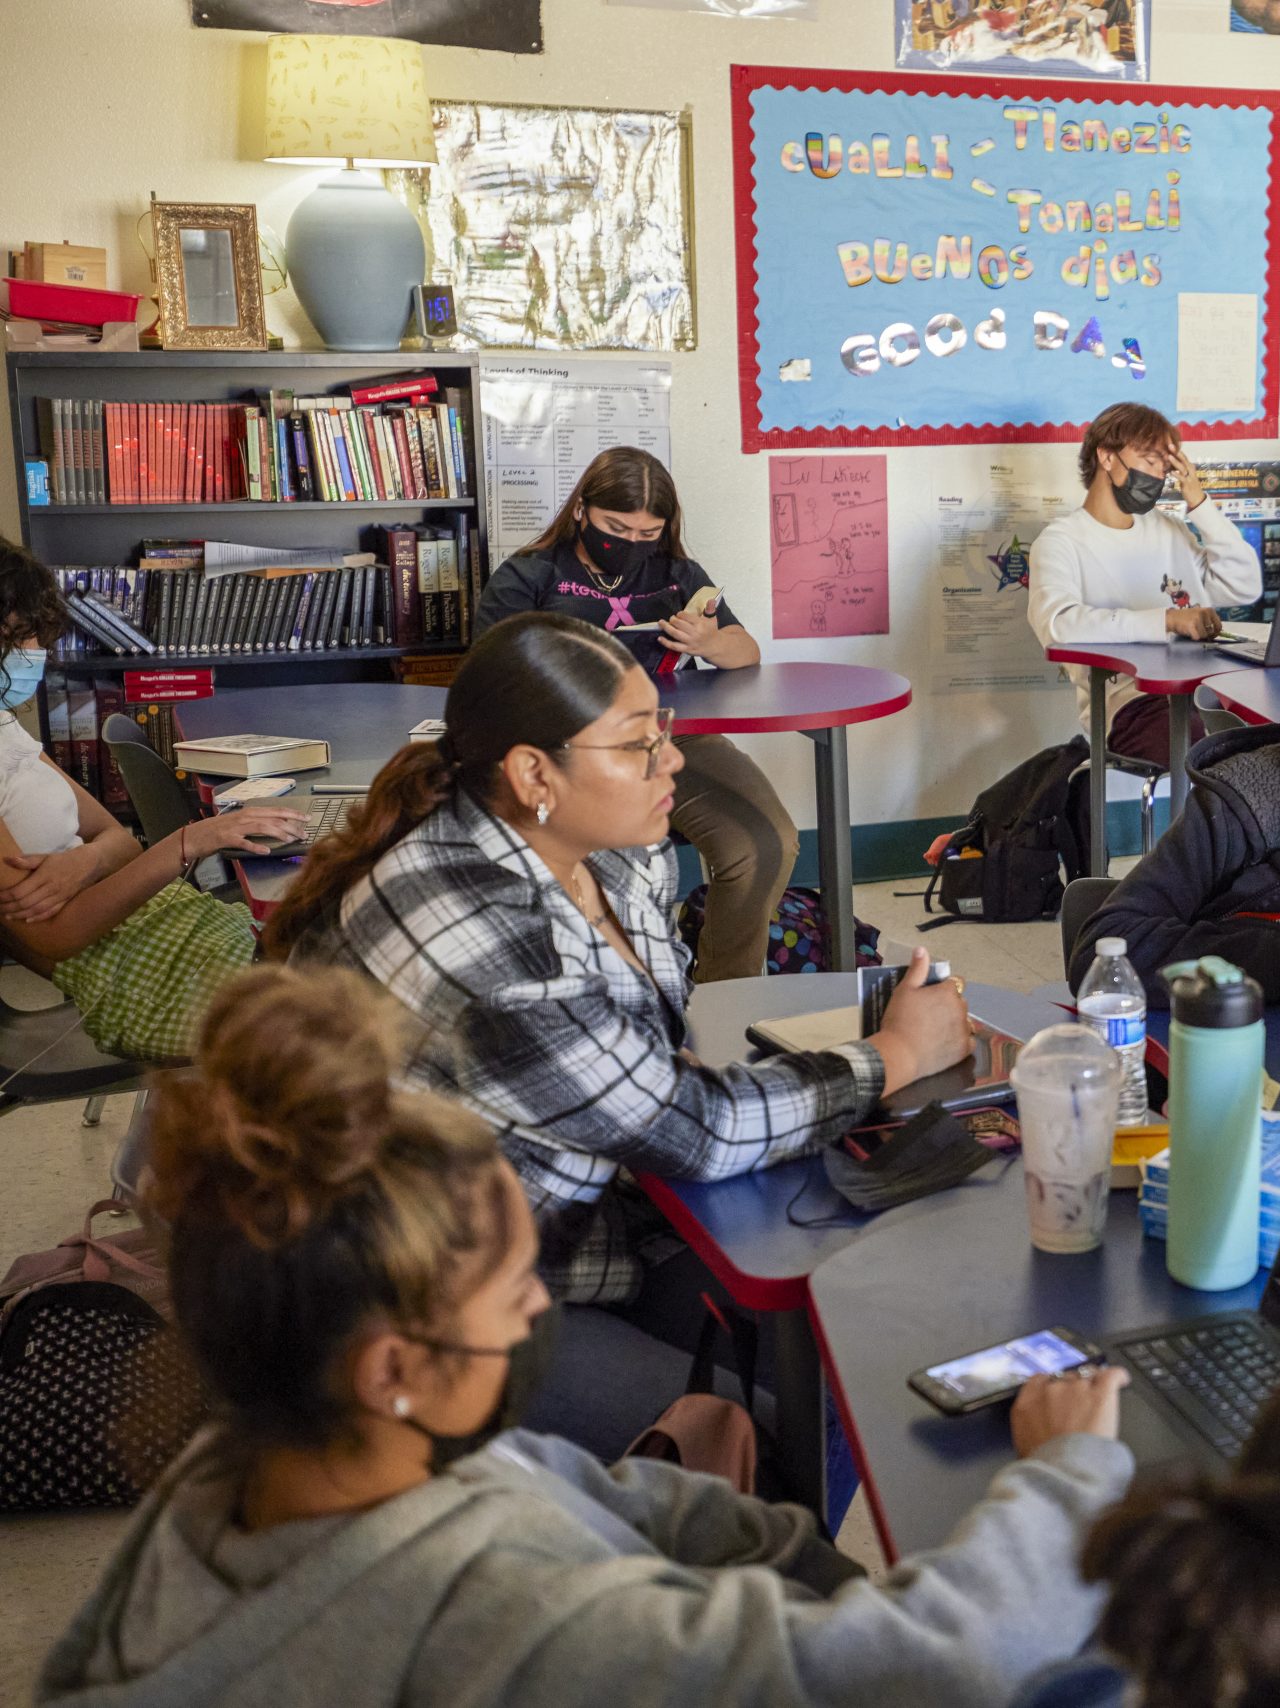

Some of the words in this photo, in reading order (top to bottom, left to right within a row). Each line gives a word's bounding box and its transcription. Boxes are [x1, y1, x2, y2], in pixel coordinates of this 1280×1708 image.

[1003, 104, 1192, 155] Tlanezic
[528, 368, 569, 378] Thinking
[27, 469, 36, 499] English
